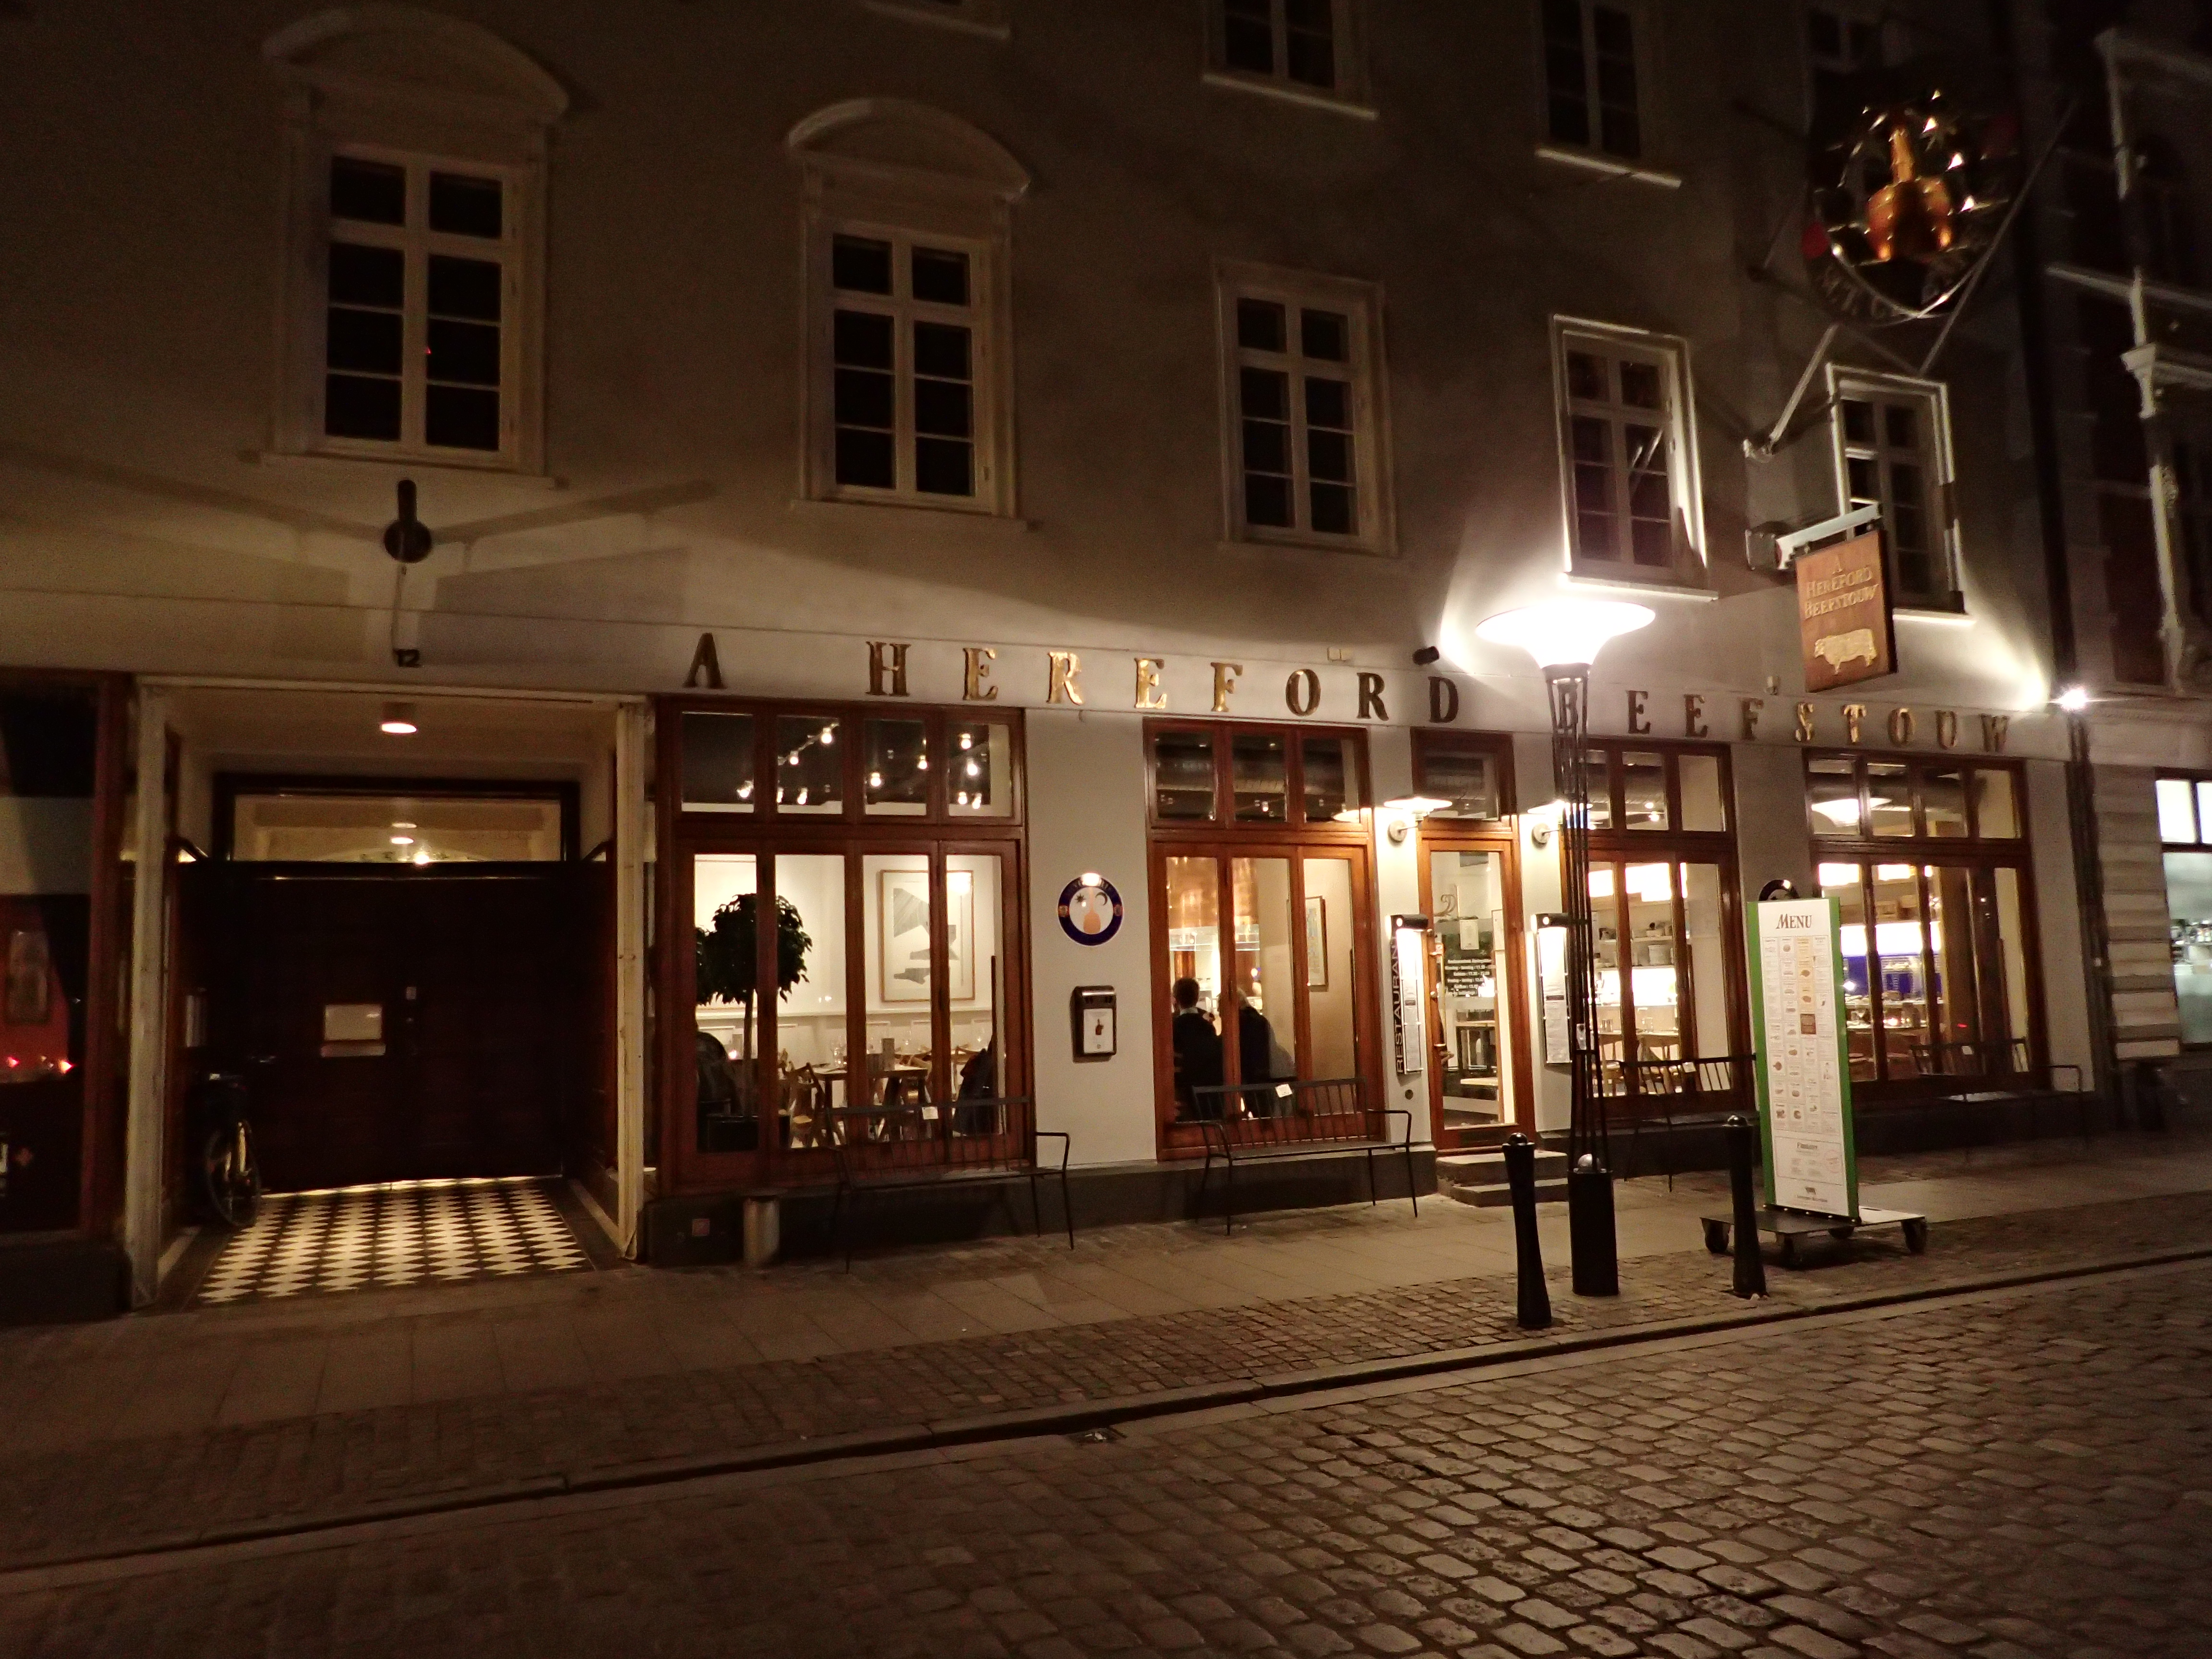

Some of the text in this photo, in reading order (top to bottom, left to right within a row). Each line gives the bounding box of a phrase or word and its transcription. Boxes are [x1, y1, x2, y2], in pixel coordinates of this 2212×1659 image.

[1806, 566, 1873, 600] HEREFORD
[682, 633, 2010, 752] A HEREFORD BEEFSTOUW
[1776, 914, 1812, 929] MENU
